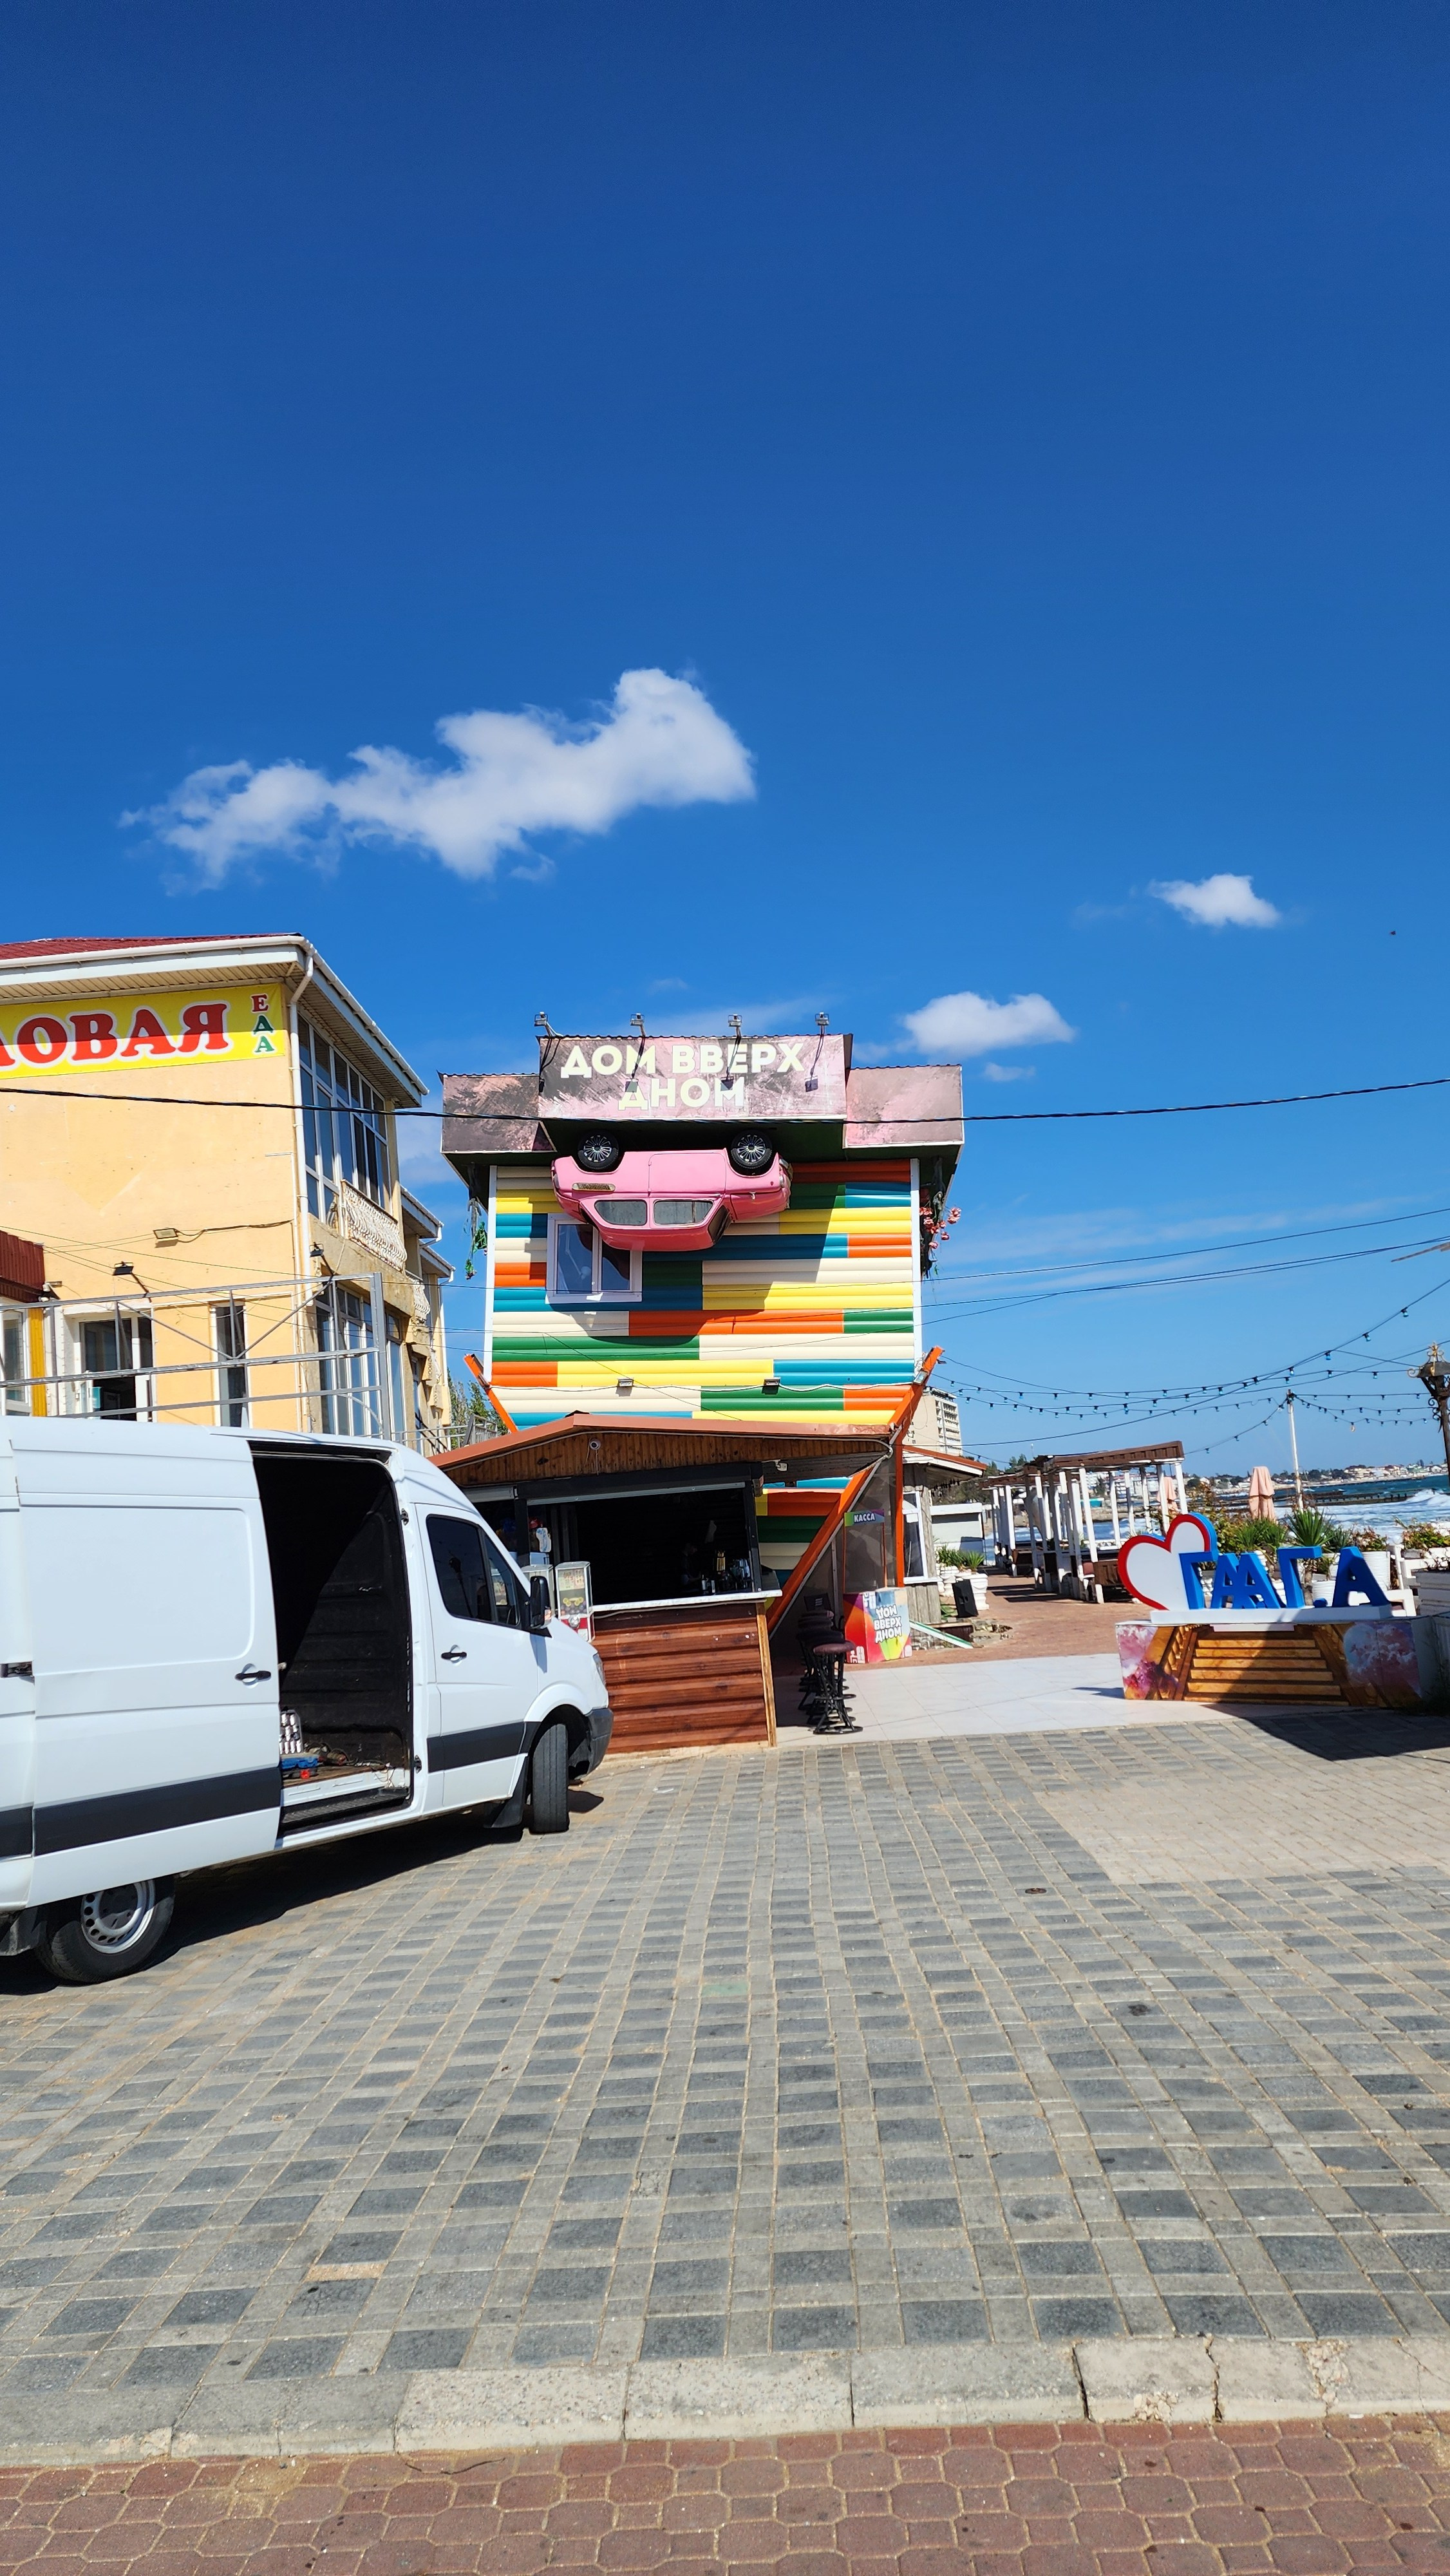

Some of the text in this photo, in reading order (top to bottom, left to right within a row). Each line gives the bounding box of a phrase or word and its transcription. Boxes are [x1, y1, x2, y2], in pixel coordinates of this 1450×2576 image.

[0, 1003, 227, 1066] ОВАЯ
[251, 994, 275, 1052] ЕДА
[561, 1043, 805, 1078] ДОМ ВВЕРХ
[619, 1077, 744, 1110] ДНОМ
[854, 1513, 875, 1522] КАССА
[874, 1616, 901, 1630] ВВЕРХ
[875, 1627, 901, 1643] ДНОМ
